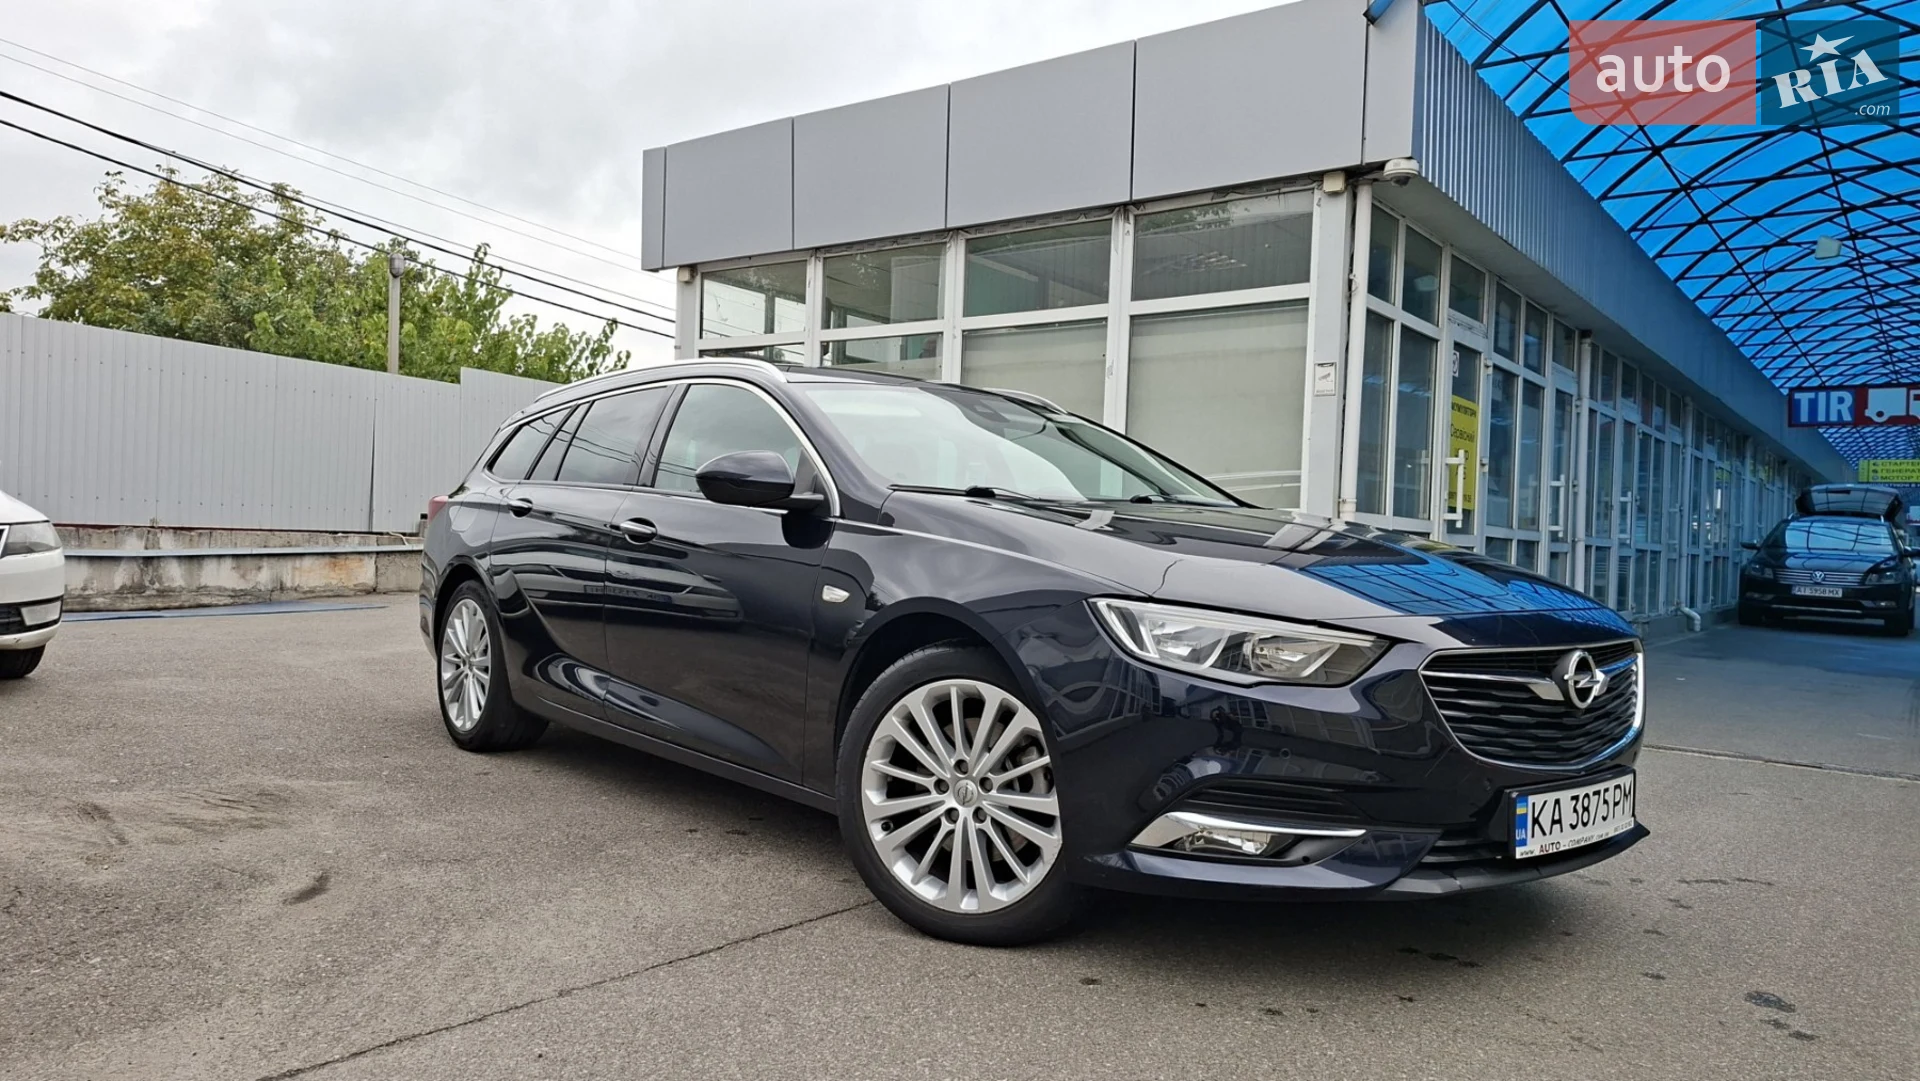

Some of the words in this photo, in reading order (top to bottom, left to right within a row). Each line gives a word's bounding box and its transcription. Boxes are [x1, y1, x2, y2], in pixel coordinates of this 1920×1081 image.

[1794, 391, 1853, 422] TIR
[1531, 798, 1563, 838] KA
[1569, 786, 1610, 830] 3875
[1612, 779, 1633, 819] PM
[1515, 828, 1527, 840] UA
[1539, 841, 1561, 854] AUTO
